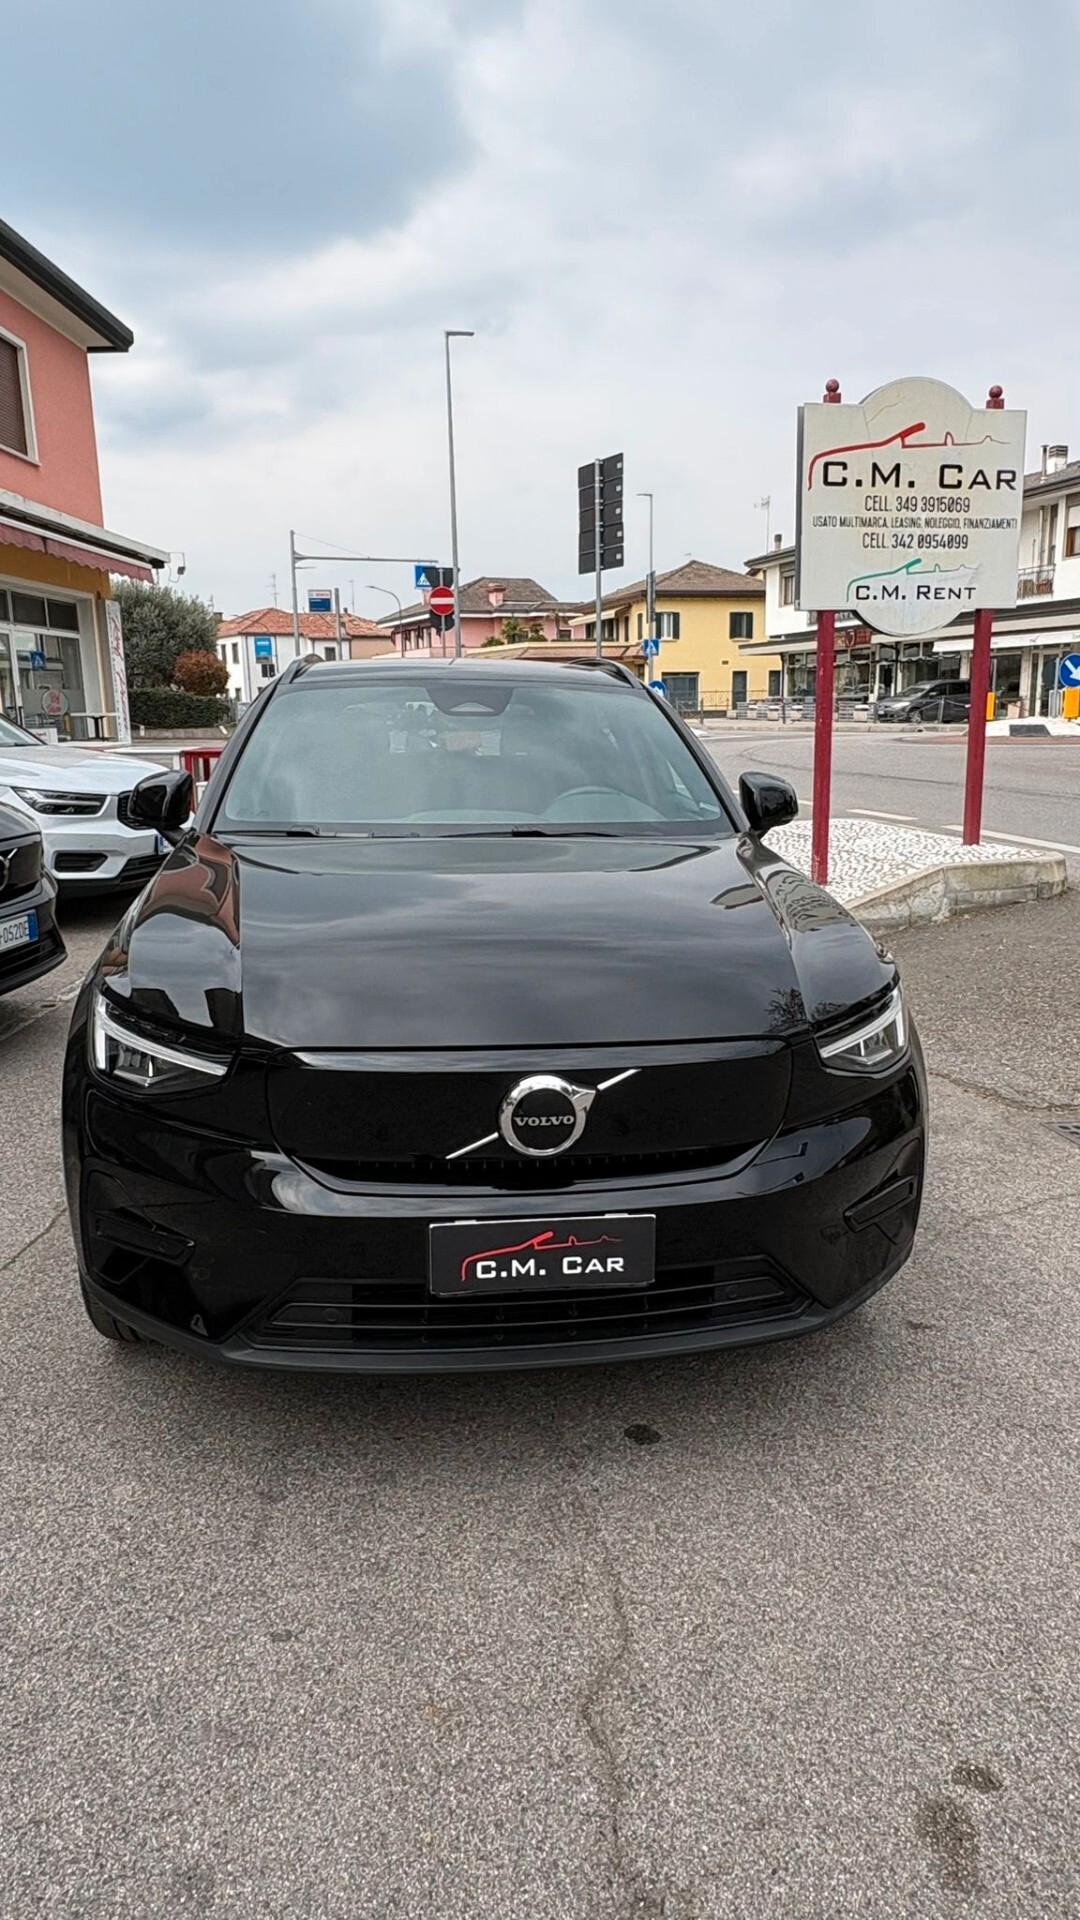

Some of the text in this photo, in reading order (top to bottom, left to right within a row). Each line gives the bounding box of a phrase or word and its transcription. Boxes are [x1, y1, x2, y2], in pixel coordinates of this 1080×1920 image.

[823, 461, 1017, 491] C.M. CAR
[864, 495, 971, 513] CELL. 349 3915069
[812, 515, 838, 528] USATO
[963, 517, 1018, 530] FINANZIAMENTI
[862, 532, 969, 550] CELL. 342 0954099
[856, 584, 977, 601] C.M. RENT
[514, 1114, 575, 1127] VOLVO
[476, 1256, 625, 1279] C.M. CAR
